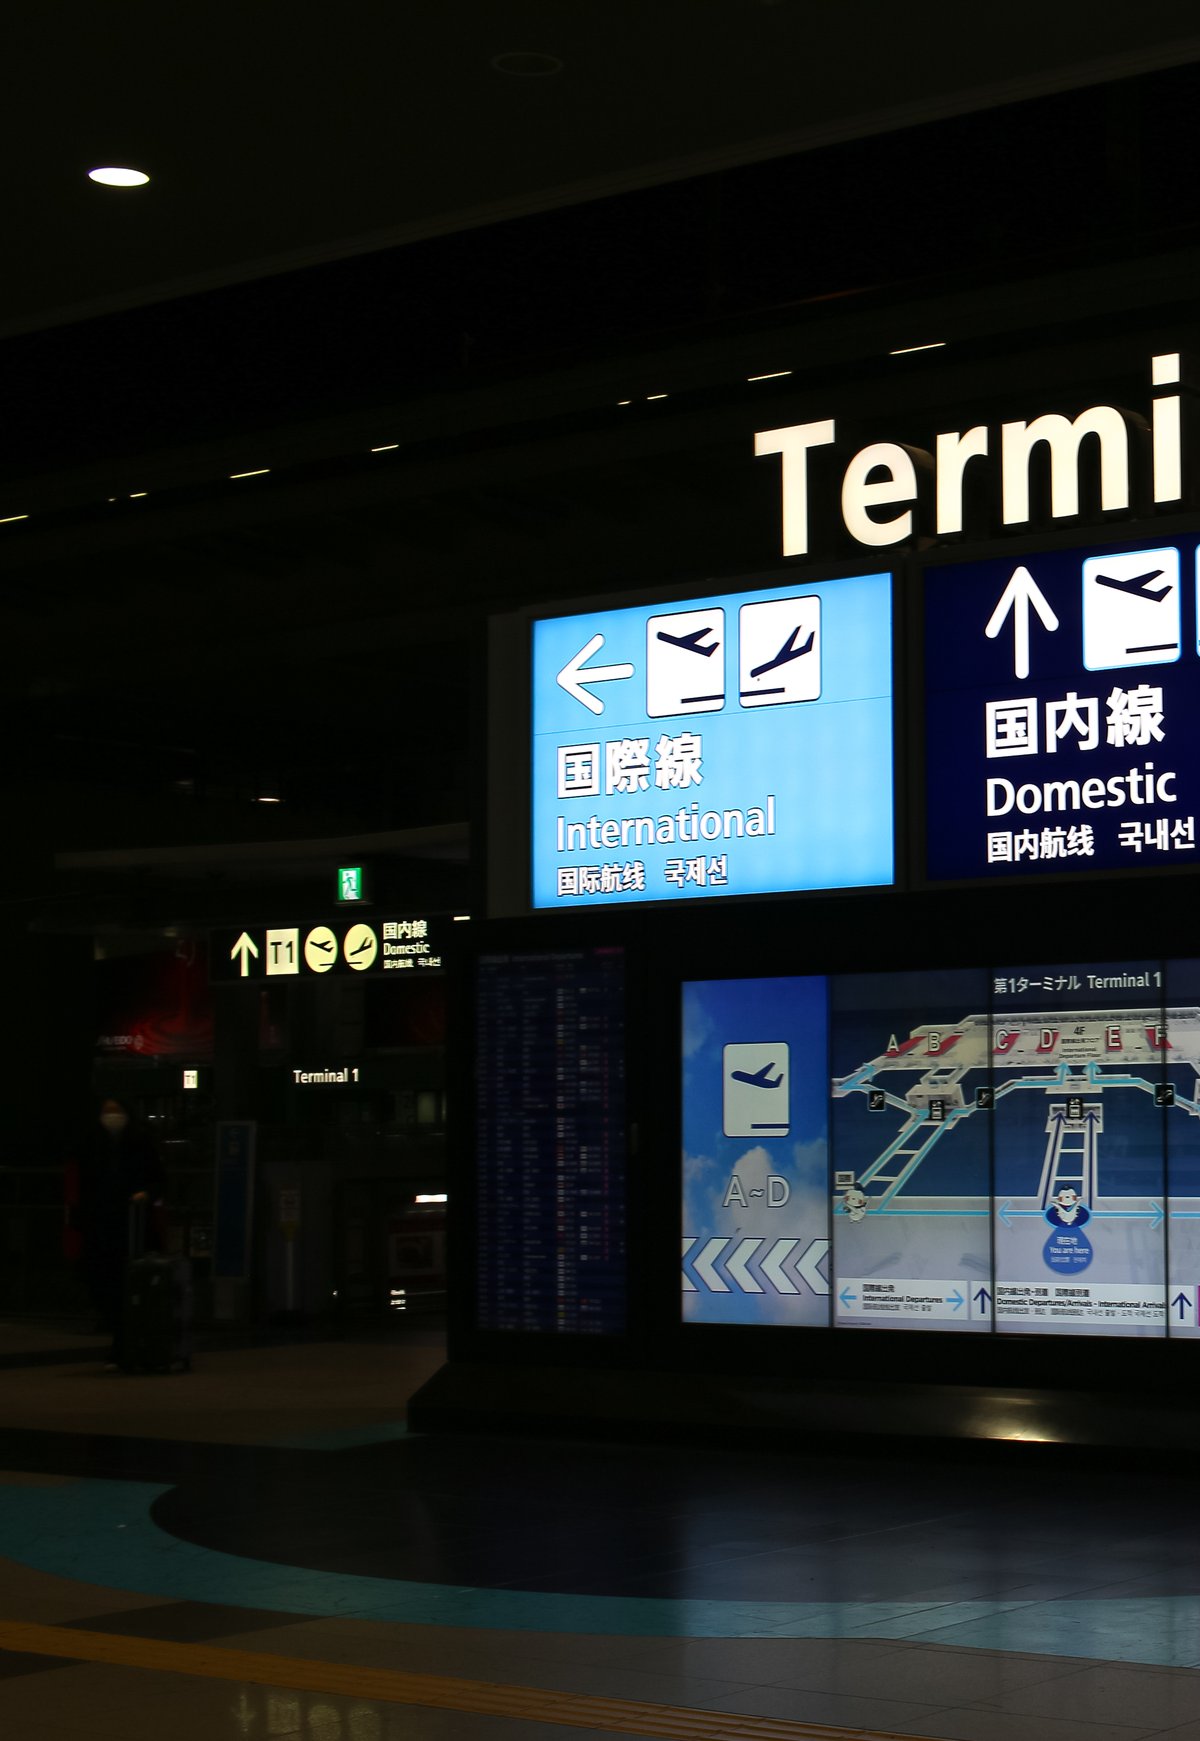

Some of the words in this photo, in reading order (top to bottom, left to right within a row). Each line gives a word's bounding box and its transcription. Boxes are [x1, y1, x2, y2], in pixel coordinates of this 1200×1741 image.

[986, 684, 1166, 758] 国内線
[557, 732, 703, 799] 国際線
[986, 762, 1177, 816] Domestic
[557, 795, 776, 851] International
[987, 824, 1095, 863] 国内航线
[1118, 816, 1195, 853] 국내선
[557, 861, 646, 897] 国际航线
[664, 854, 728, 888] 국제선
[383, 920, 428, 940] 国内線
[270, 940, 293, 964] T1
[383, 940, 430, 956] Domestic
[993, 975, 1081, 994] 第1ターミナル
[1087, 971, 1149, 989] Terminal
[1153, 971, 1162, 988] 1
[887, 1034, 899, 1052] A
[928, 1032, 941, 1052] B
[995, 1030, 1009, 1050] C
[1040, 1028, 1054, 1048] D
[1107, 1025, 1120, 1047] E
[293, 1068, 348, 1084] Terminal
[352, 1069, 359, 1082] 1
[862, 1294, 904, 1303] International
[905, 1295, 943, 1304] Departures
[1098, 1300, 1140, 1308] International
